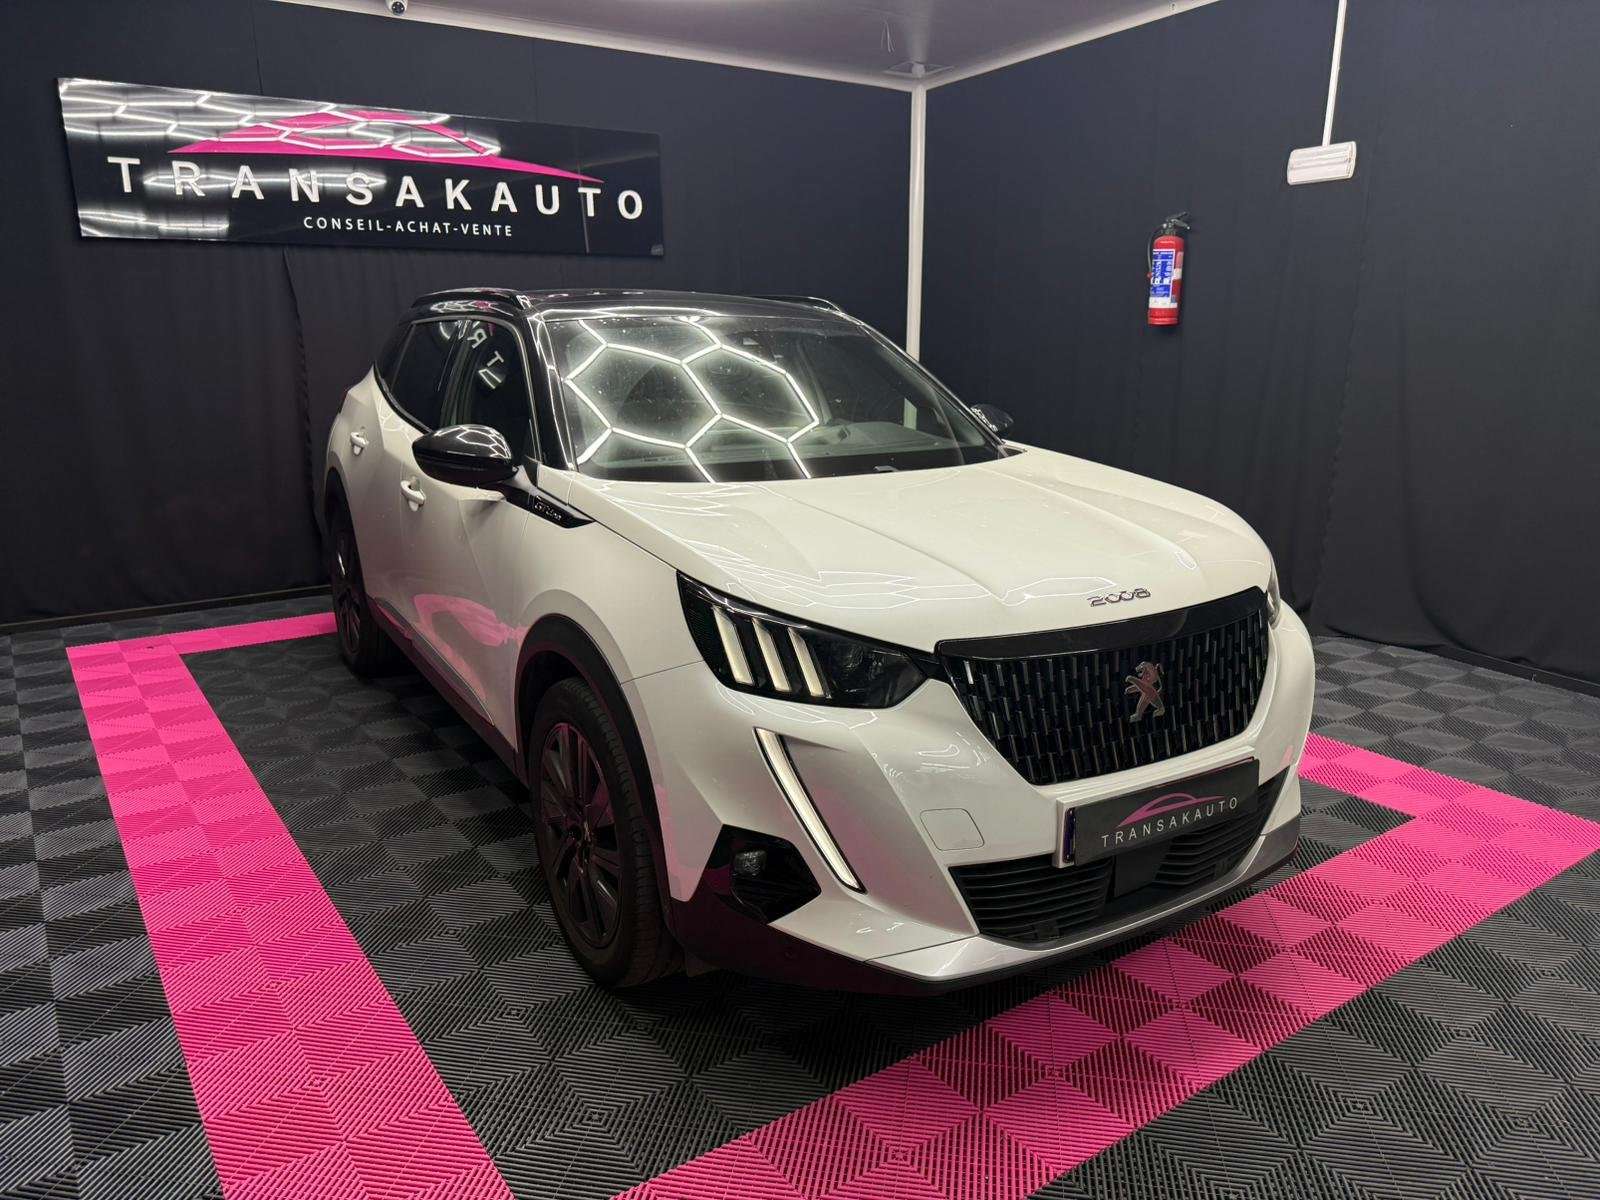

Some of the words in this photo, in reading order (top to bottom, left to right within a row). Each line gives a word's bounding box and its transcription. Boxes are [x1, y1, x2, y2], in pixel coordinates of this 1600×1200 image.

[108, 156, 643, 219] TRANSAKAUTO
[303, 216, 513, 237] CONSEIL-ACHAT-VENTE
[1087, 588, 1151, 607] 2008
[1101, 797, 1238, 848] TRANSAKAUTO
